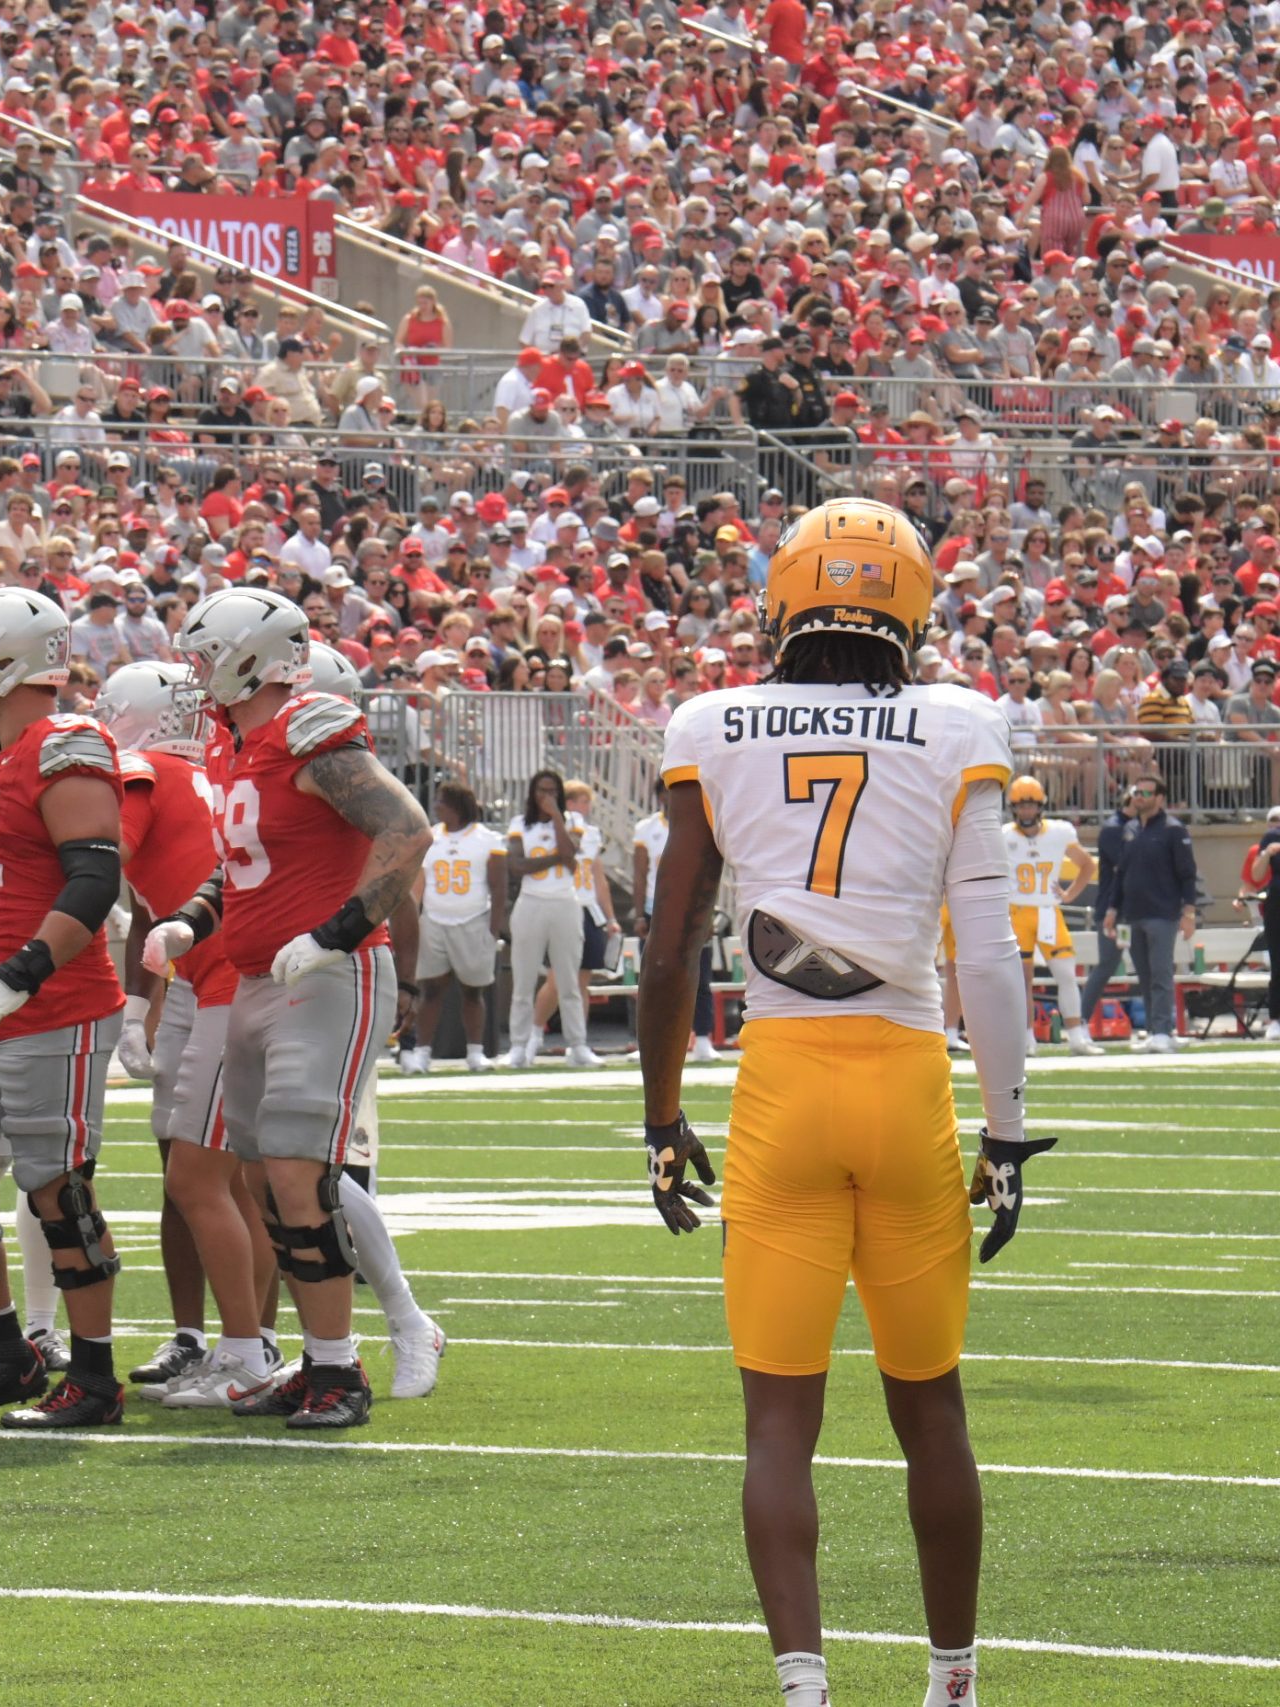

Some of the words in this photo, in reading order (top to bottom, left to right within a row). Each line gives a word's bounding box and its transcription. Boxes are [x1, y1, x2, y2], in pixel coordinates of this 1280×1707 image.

[137, 215, 281, 276] NATOS
[286, 230, 299, 272] PIZZA
[312, 231, 332, 256] 26
[317, 257, 329, 274] A
[828, 567, 853, 576] MAC
[724, 706, 926, 747] STOCKSTILL
[783, 751, 869, 899] 7
[433, 860, 471, 894] 95
[1016, 862, 1053, 894] 97
